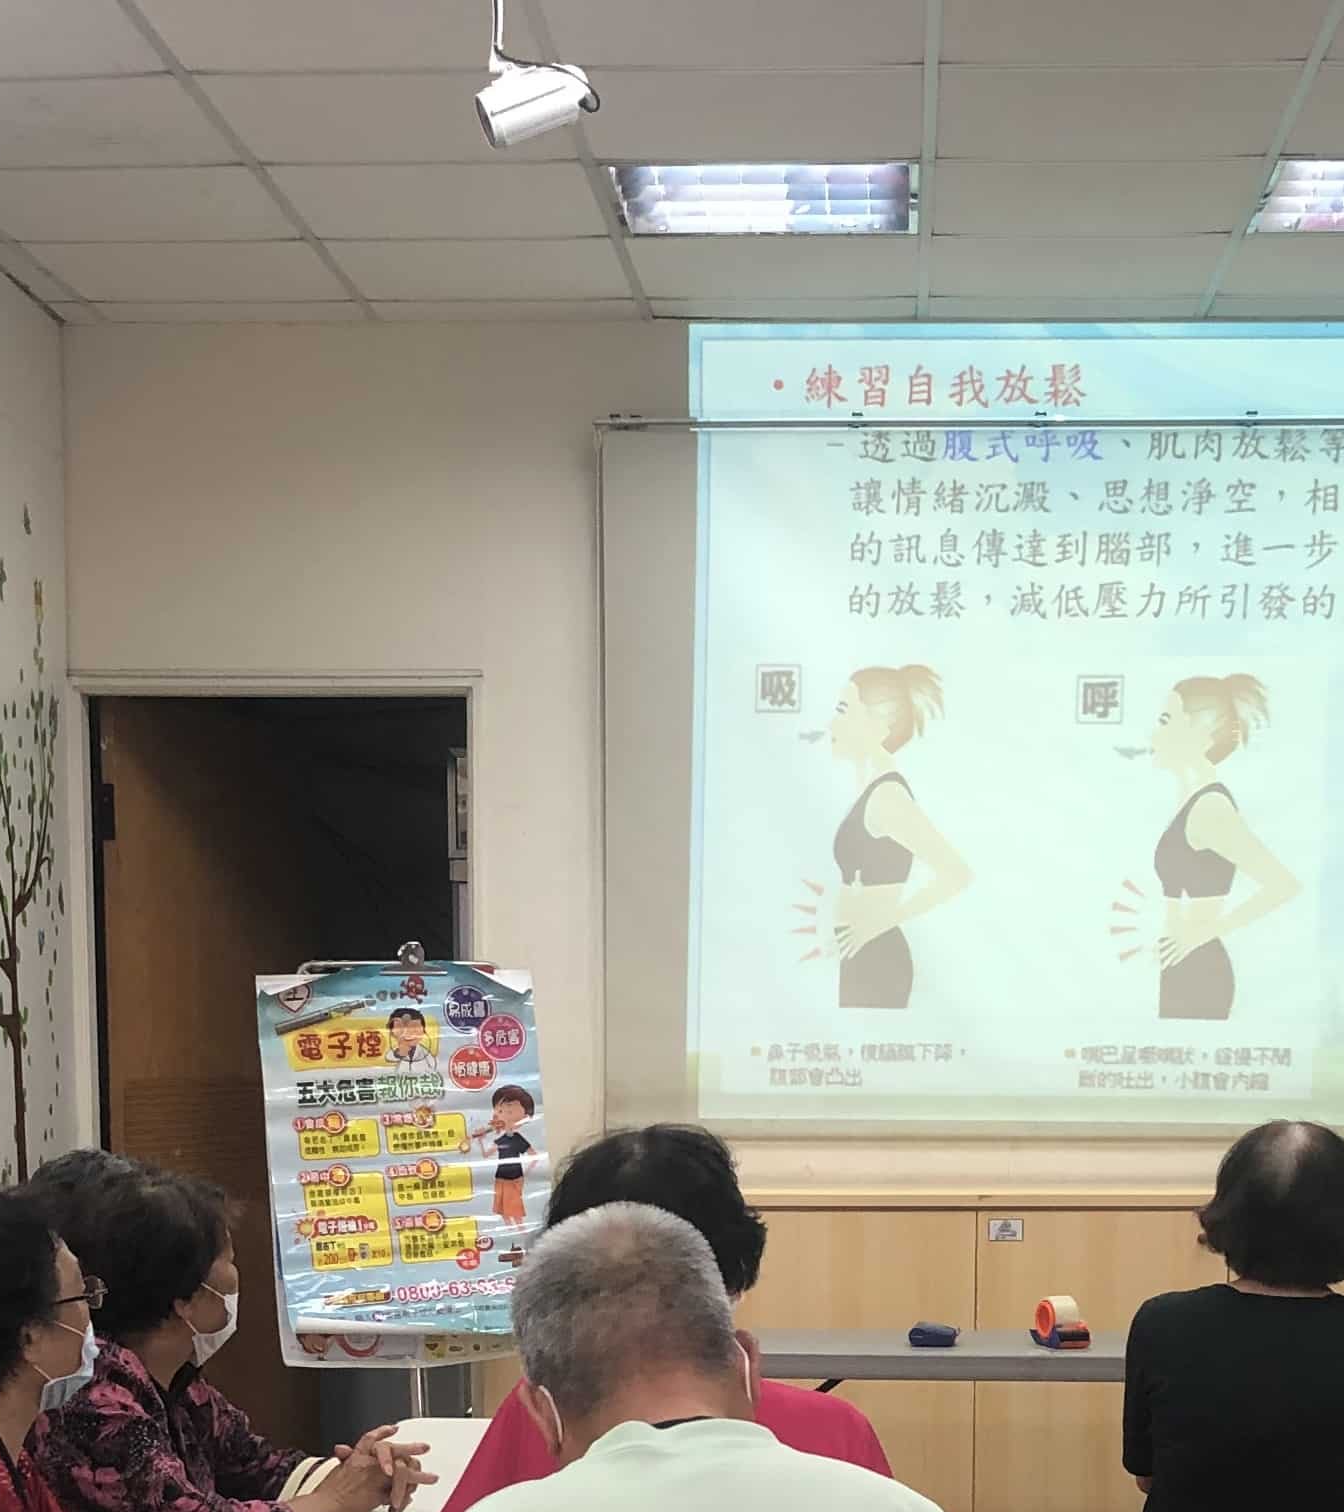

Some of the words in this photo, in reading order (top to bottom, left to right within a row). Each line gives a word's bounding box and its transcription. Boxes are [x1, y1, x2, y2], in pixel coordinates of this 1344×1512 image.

[805, 363, 1087, 408] 練習自我放鬆
[760, 669, 797, 707] 吸
[1081, 680, 1120, 719] 呼
[296, 1031, 382, 1062] 電子煙
